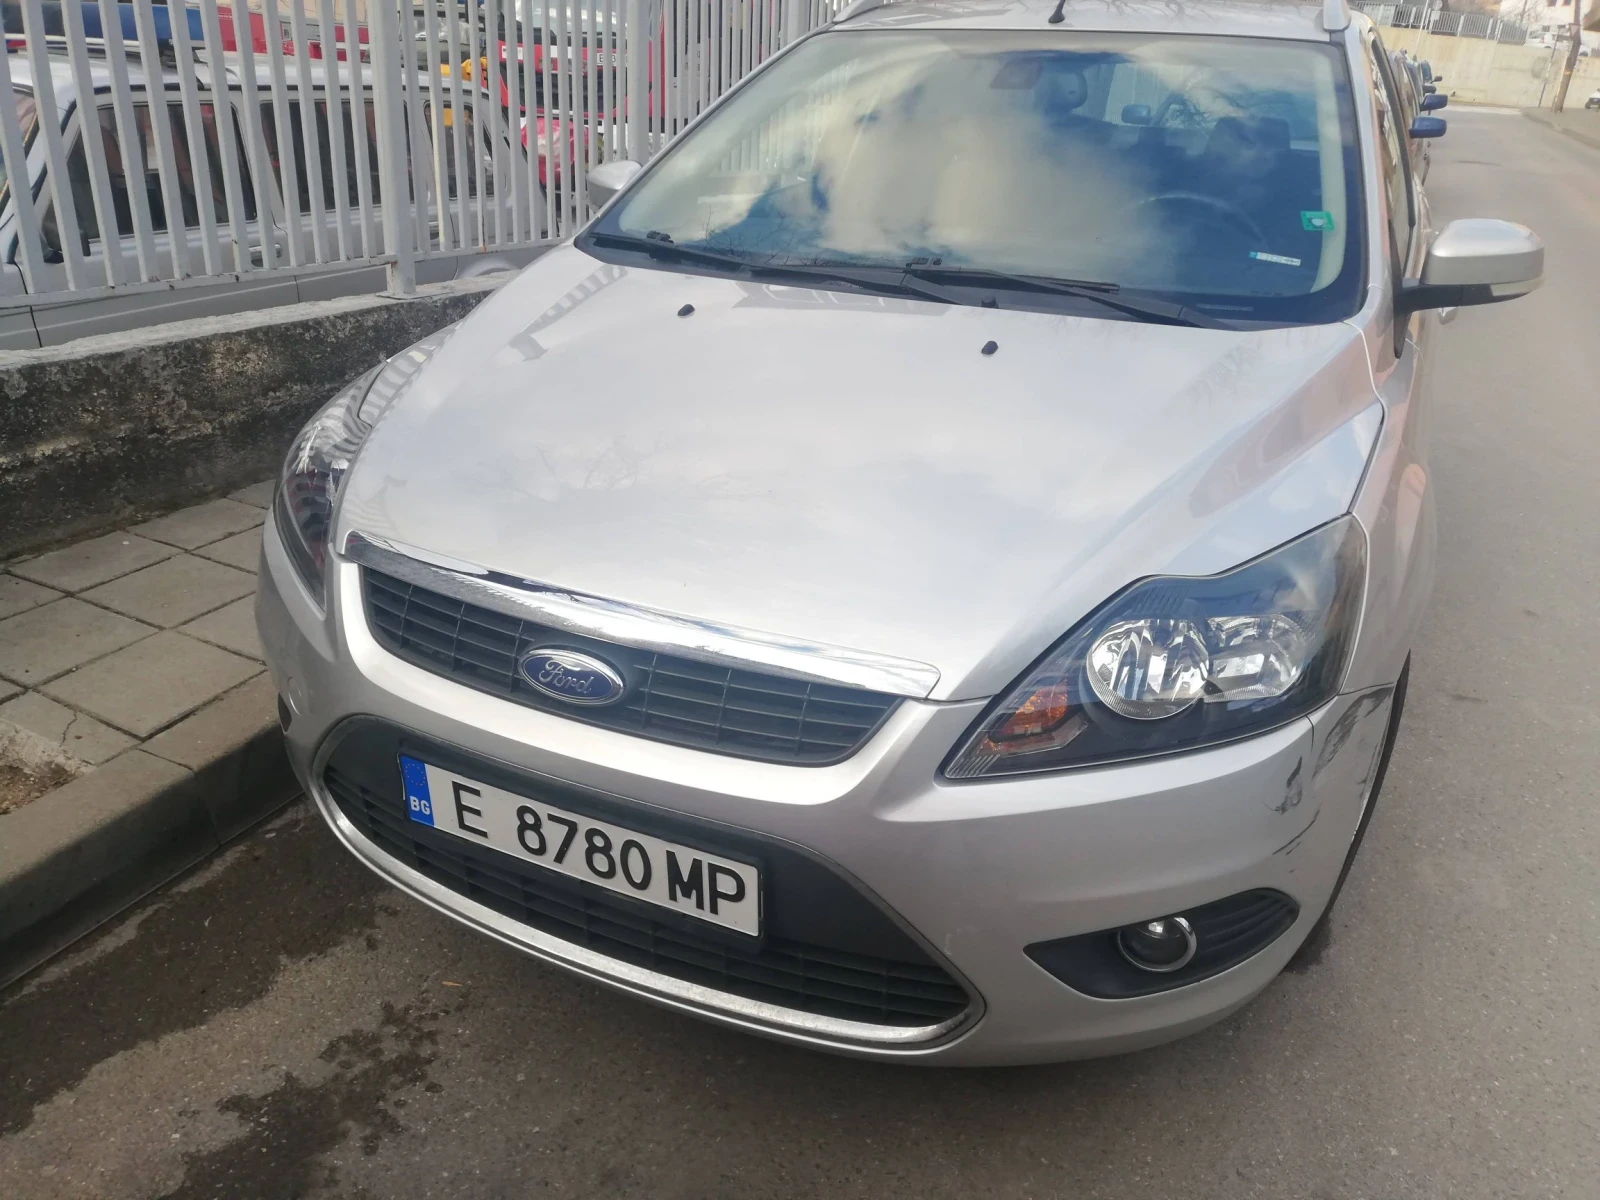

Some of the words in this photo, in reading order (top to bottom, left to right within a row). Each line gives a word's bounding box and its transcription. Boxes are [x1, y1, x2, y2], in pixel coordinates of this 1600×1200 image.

[538, 659, 595, 694] Ford
[409, 795, 431, 815] BG
[451, 780, 489, 839] E
[516, 804, 652, 891] 8780
[666, 849, 746, 915] MP
